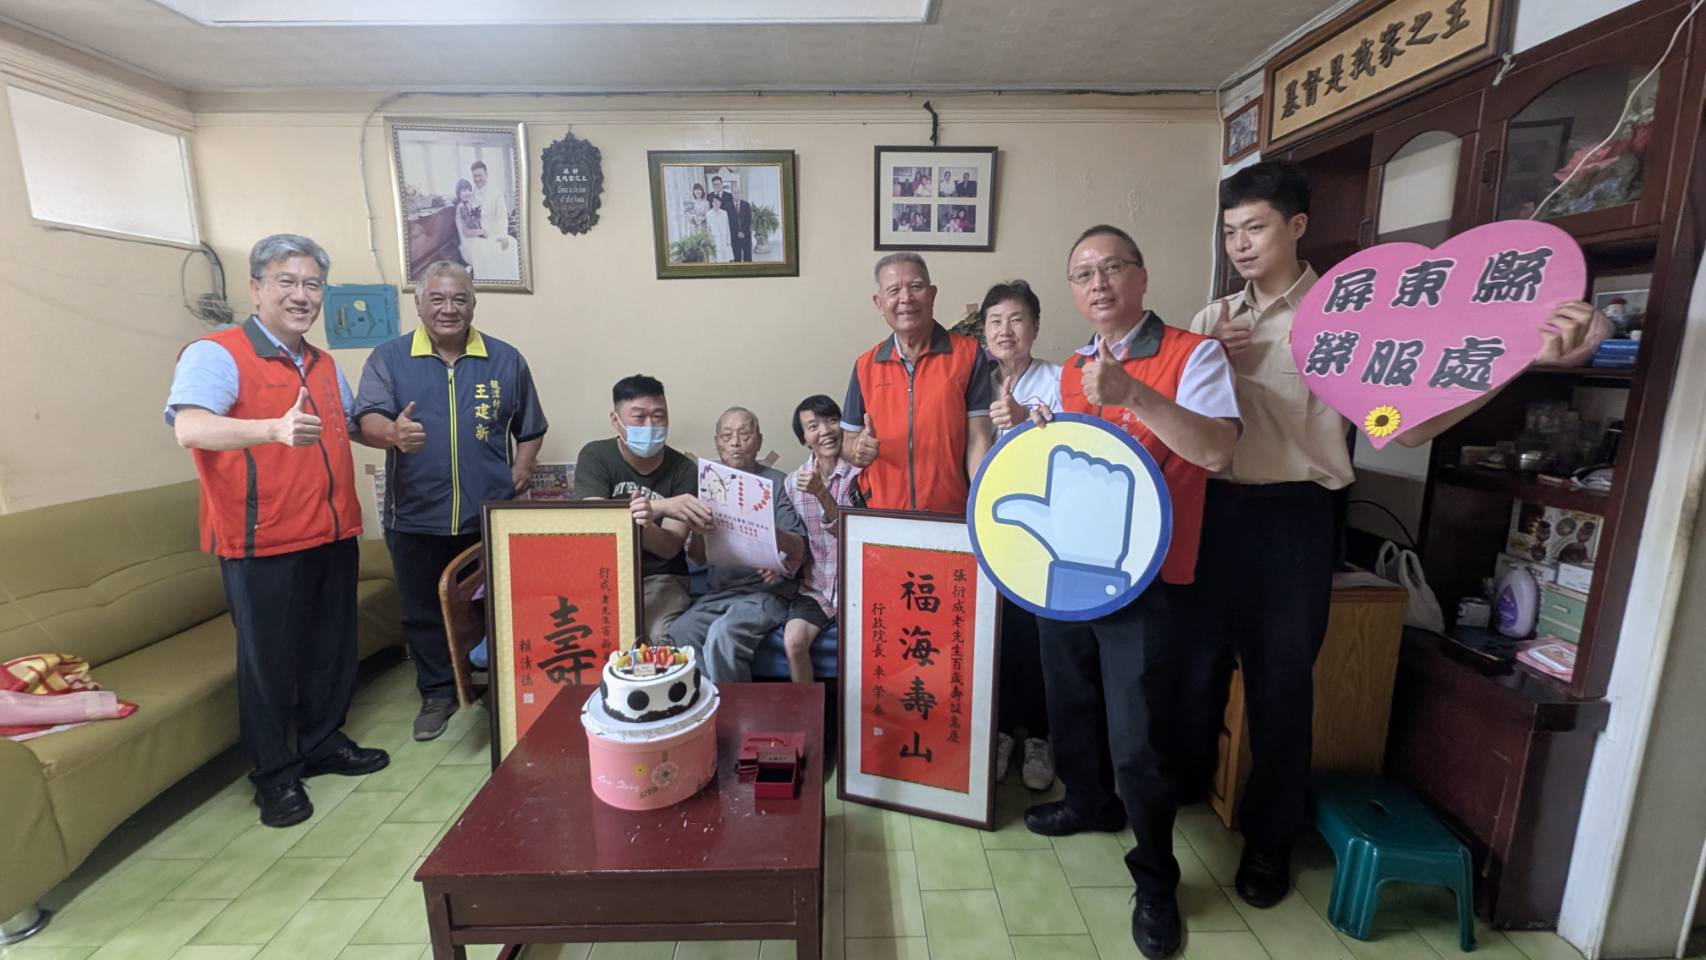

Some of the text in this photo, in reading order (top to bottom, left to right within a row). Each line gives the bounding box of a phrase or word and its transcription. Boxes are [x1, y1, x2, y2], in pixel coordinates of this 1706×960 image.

[1281, 0, 1471, 120] 基督是我家之主
[1323, 247, 1554, 313] 屏東縣
[1304, 331, 1505, 391] 榮服處
[537, 595, 597, 685] 壽
[899, 571, 941, 763] 福海壽山
